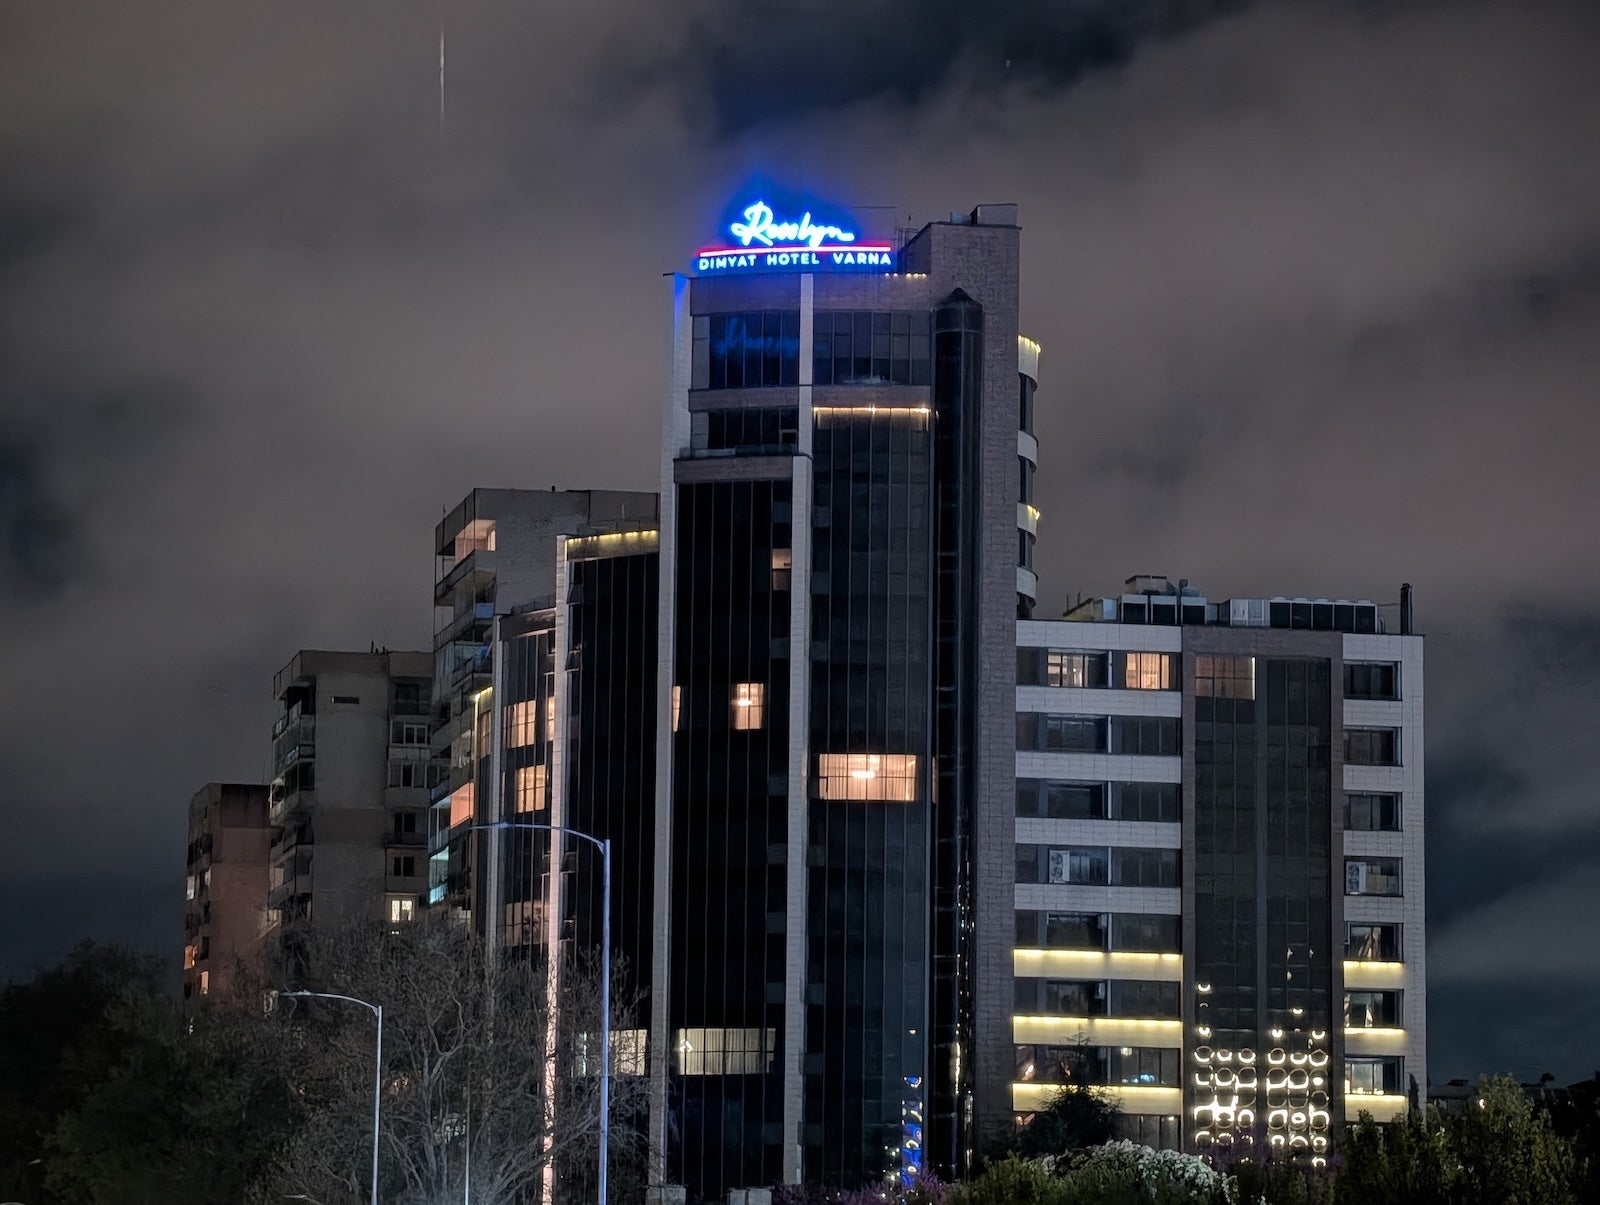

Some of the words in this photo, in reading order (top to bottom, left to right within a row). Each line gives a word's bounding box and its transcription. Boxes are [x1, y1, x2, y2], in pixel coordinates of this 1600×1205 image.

[698, 254, 758, 271] DIMYAT
[766, 252, 821, 267] HOTEL
[832, 251, 892, 266] VARNA
